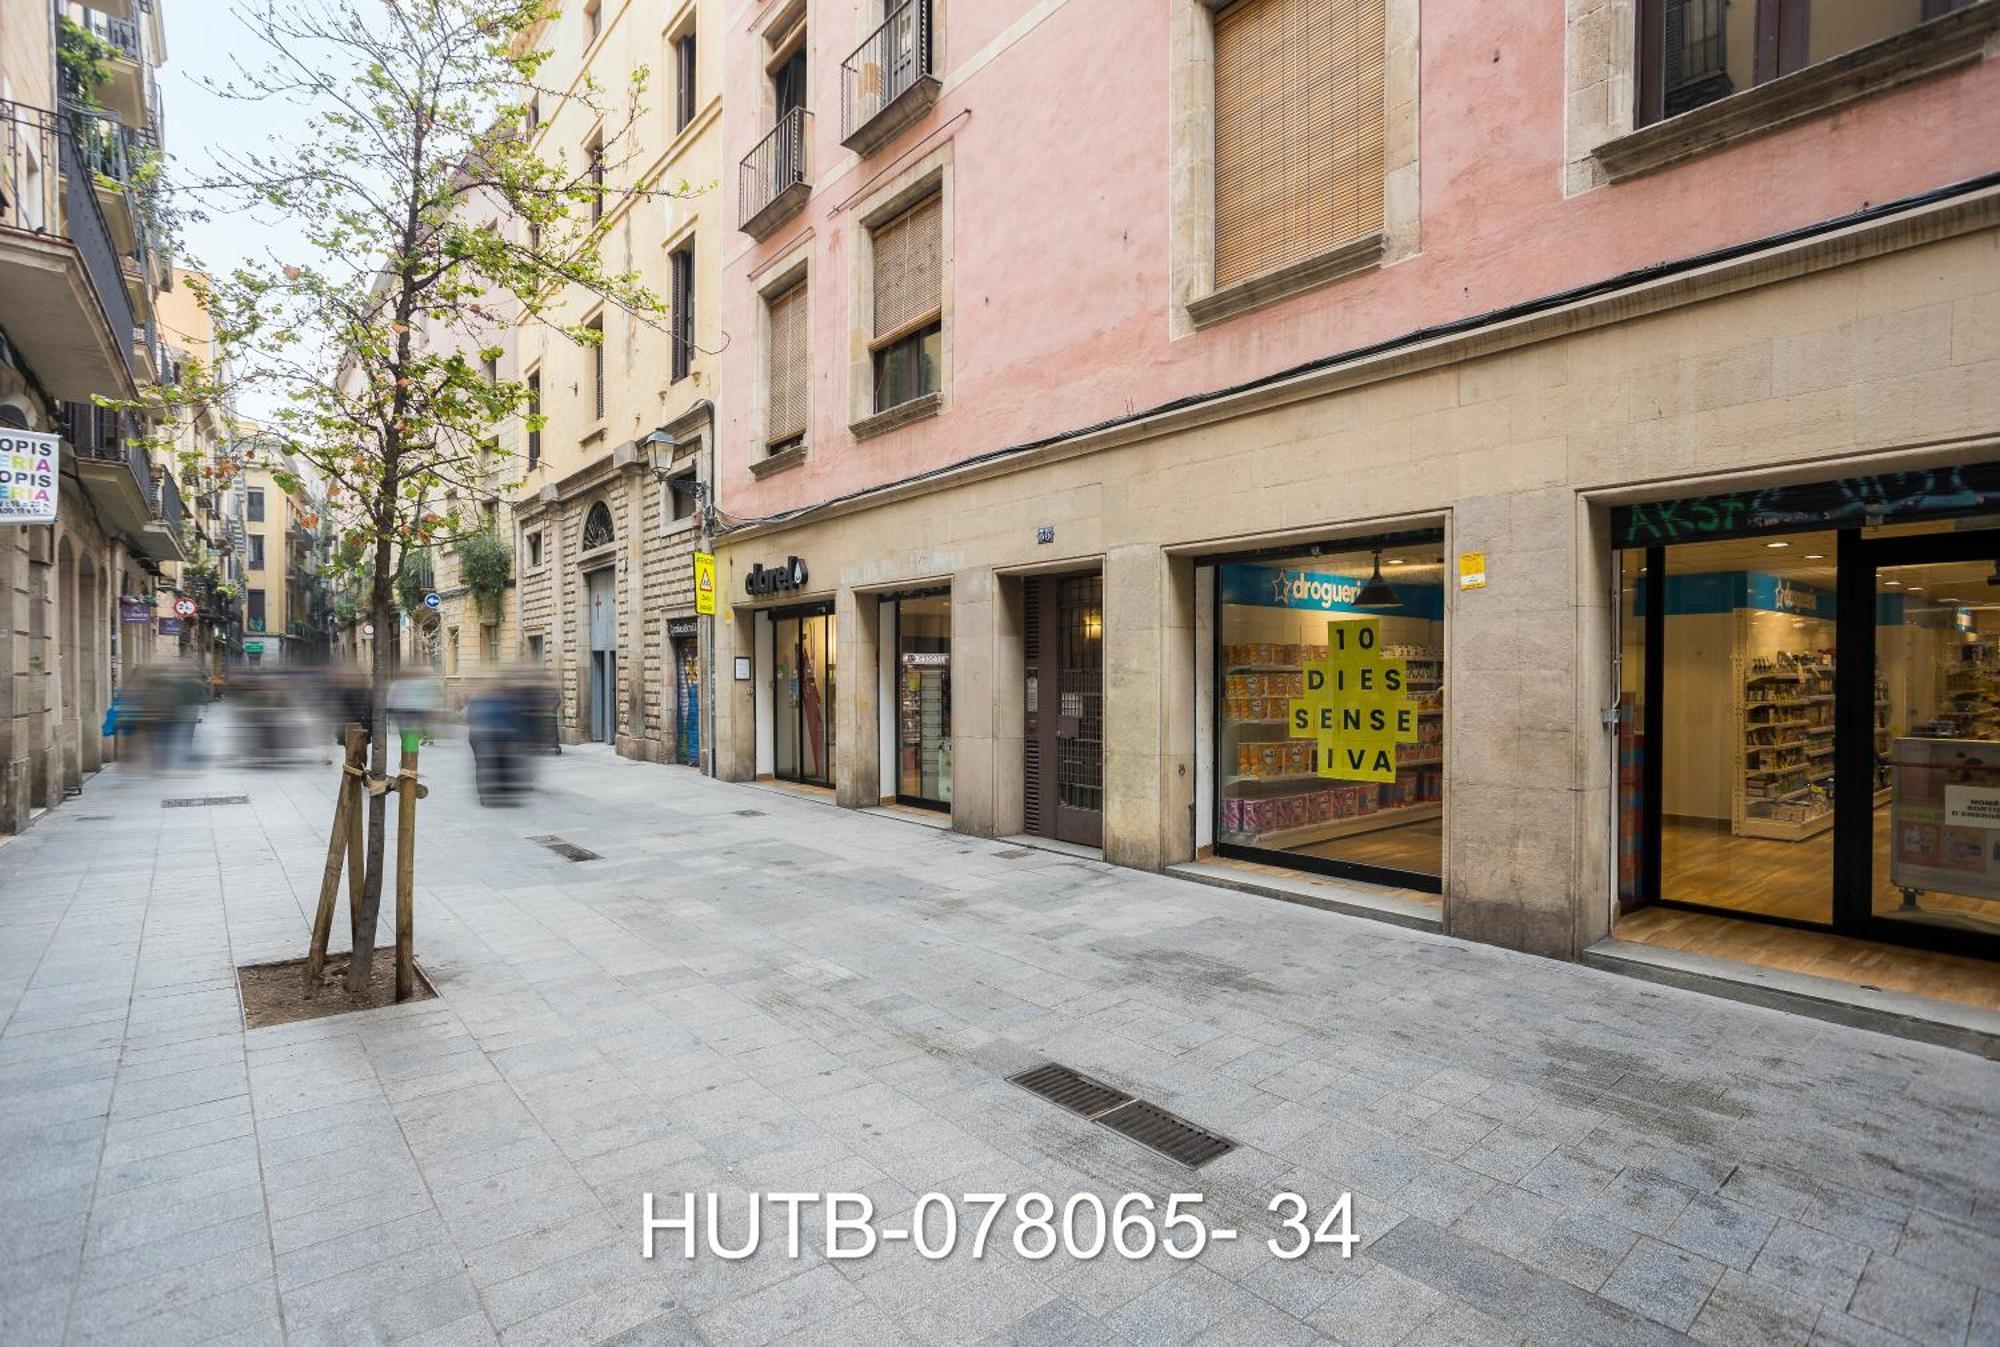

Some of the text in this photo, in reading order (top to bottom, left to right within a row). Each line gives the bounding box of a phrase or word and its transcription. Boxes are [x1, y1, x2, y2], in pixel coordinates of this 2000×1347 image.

[1292, 572, 1361, 608] drogueri
[1335, 627, 1374, 650] 10
[1307, 669, 1401, 691] DIES
[1295, 708, 1410, 732] SENSE
[1327, 748, 1392, 772] IVA
